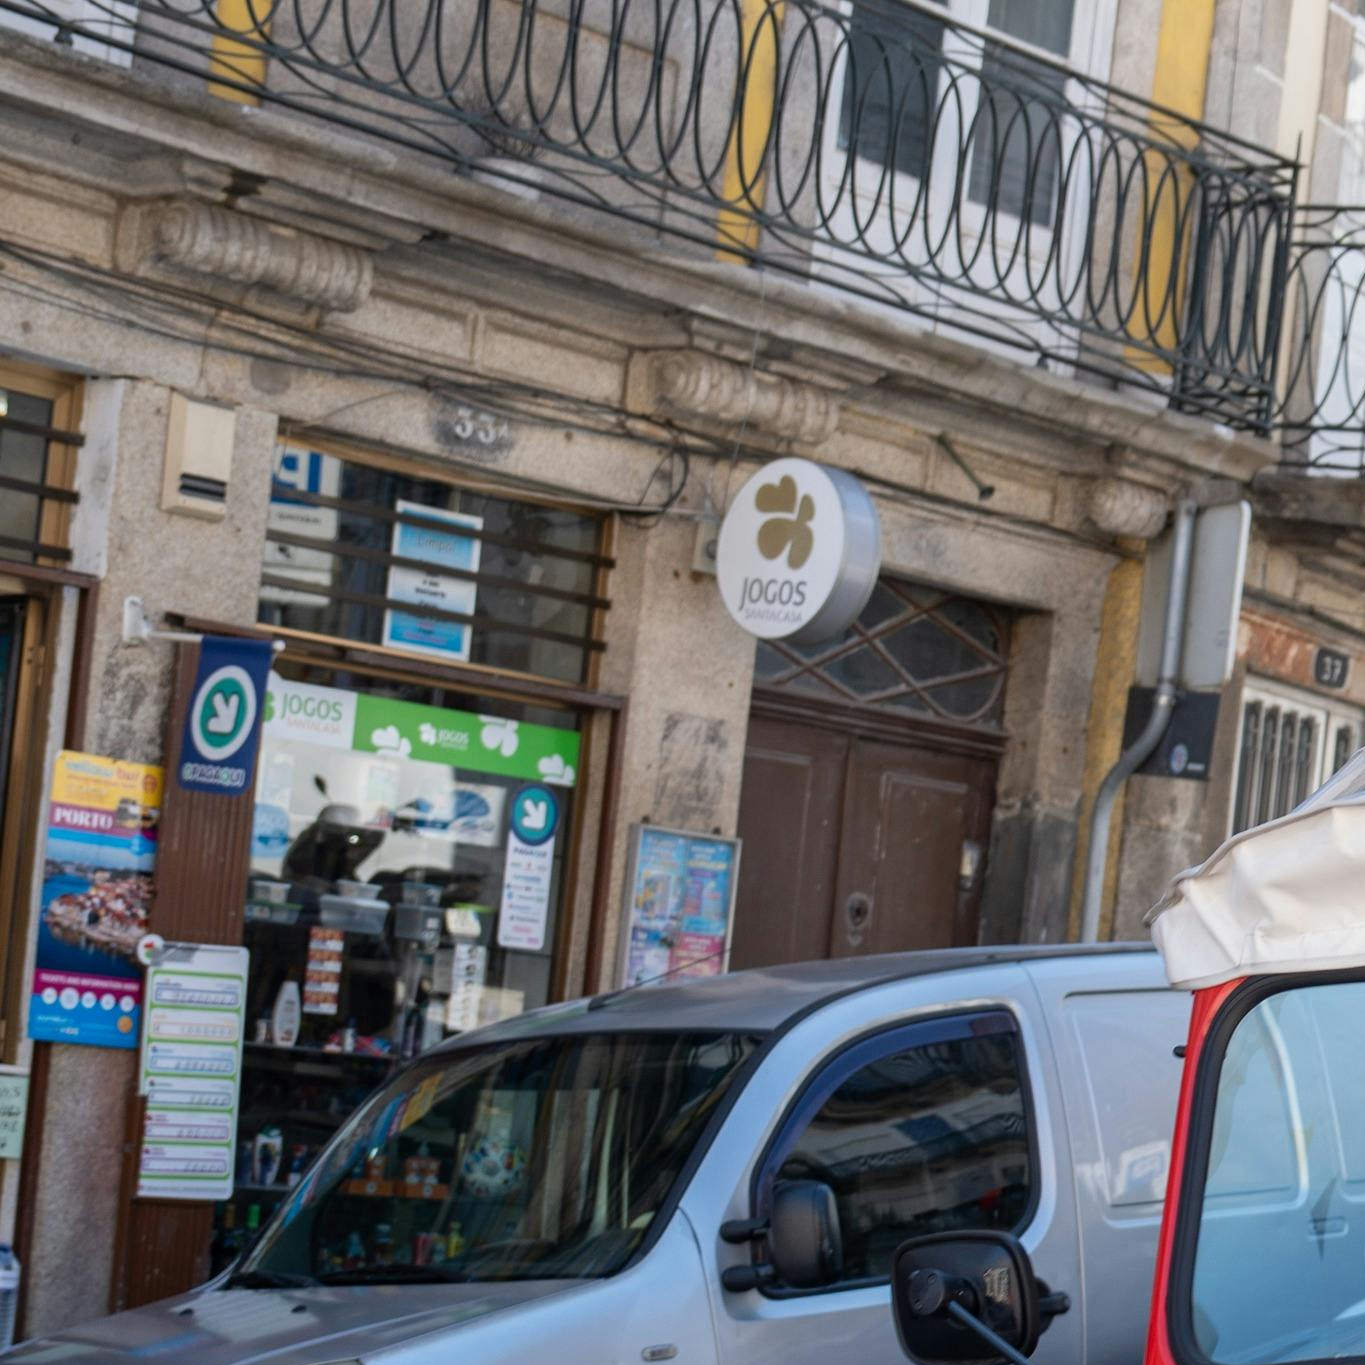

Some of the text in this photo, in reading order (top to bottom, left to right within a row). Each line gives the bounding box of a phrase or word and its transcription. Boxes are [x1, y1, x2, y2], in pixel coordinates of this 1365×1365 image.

[739, 577, 808, 612] JOGOS
[280, 692, 343, 722] JOGOS
[437, 728, 469, 745] JOGOS
[54, 806, 114, 829] PORTO
